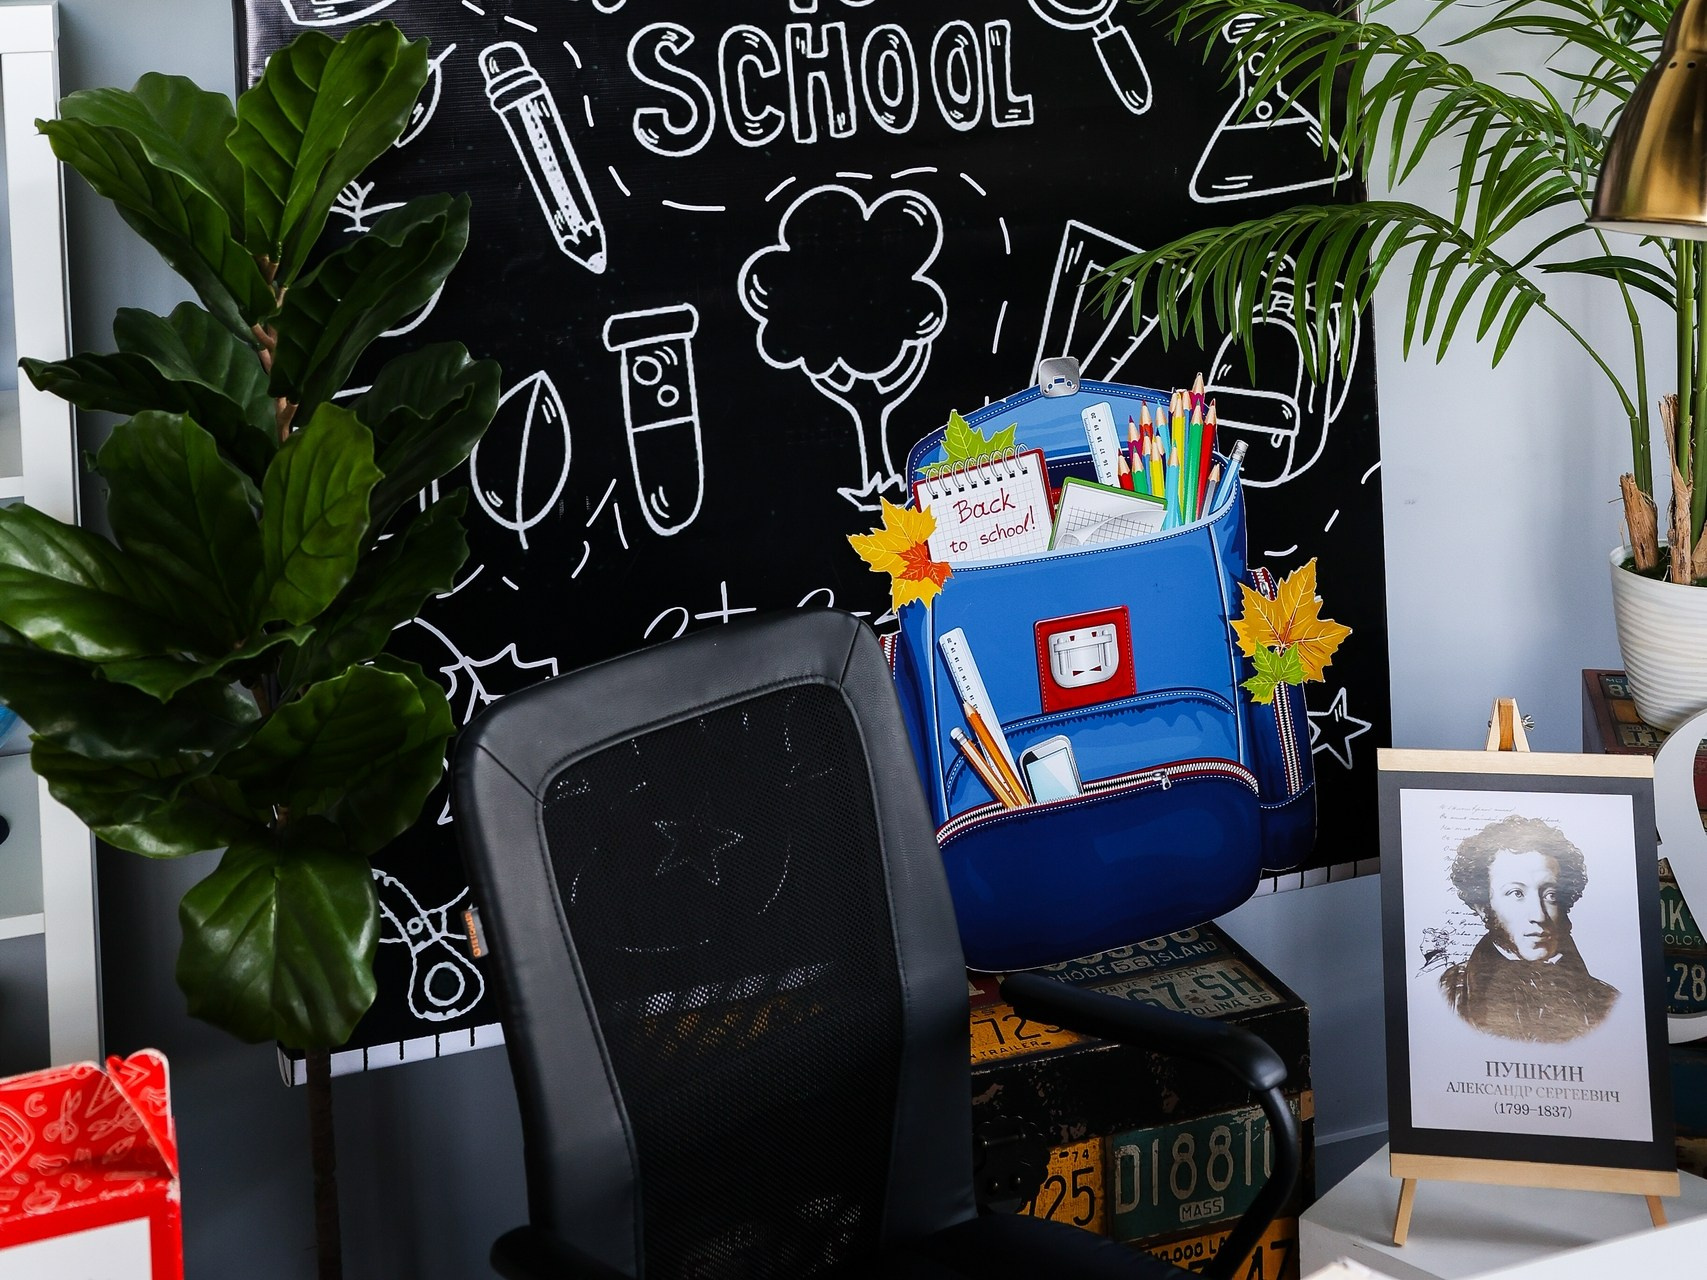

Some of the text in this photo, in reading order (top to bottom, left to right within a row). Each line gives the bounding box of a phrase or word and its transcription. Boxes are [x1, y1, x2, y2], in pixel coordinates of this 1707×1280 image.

[626, 19, 1034, 158] SCHOOL
[952, 487, 1017, 524] Back
[949, 505, 1036, 554] to school!
[1049, 965, 1112, 984] HODE
[1114, 957, 1149, 972] 56
[1150, 940, 1218, 965] ISLAND
[1149, 968, 1199, 984] SAFELY
[972, 1014, 1065, 1045] 72
[979, 1040, 1040, 1057] TRAILER
[1485, 1060, 1585, 1083] ПУШКИН
[1446, 1081, 1621, 1103] АЛЕКСАНДР СЕРГЕЕВИЧ
[1181, 1198, 1223, 1220] MASS
